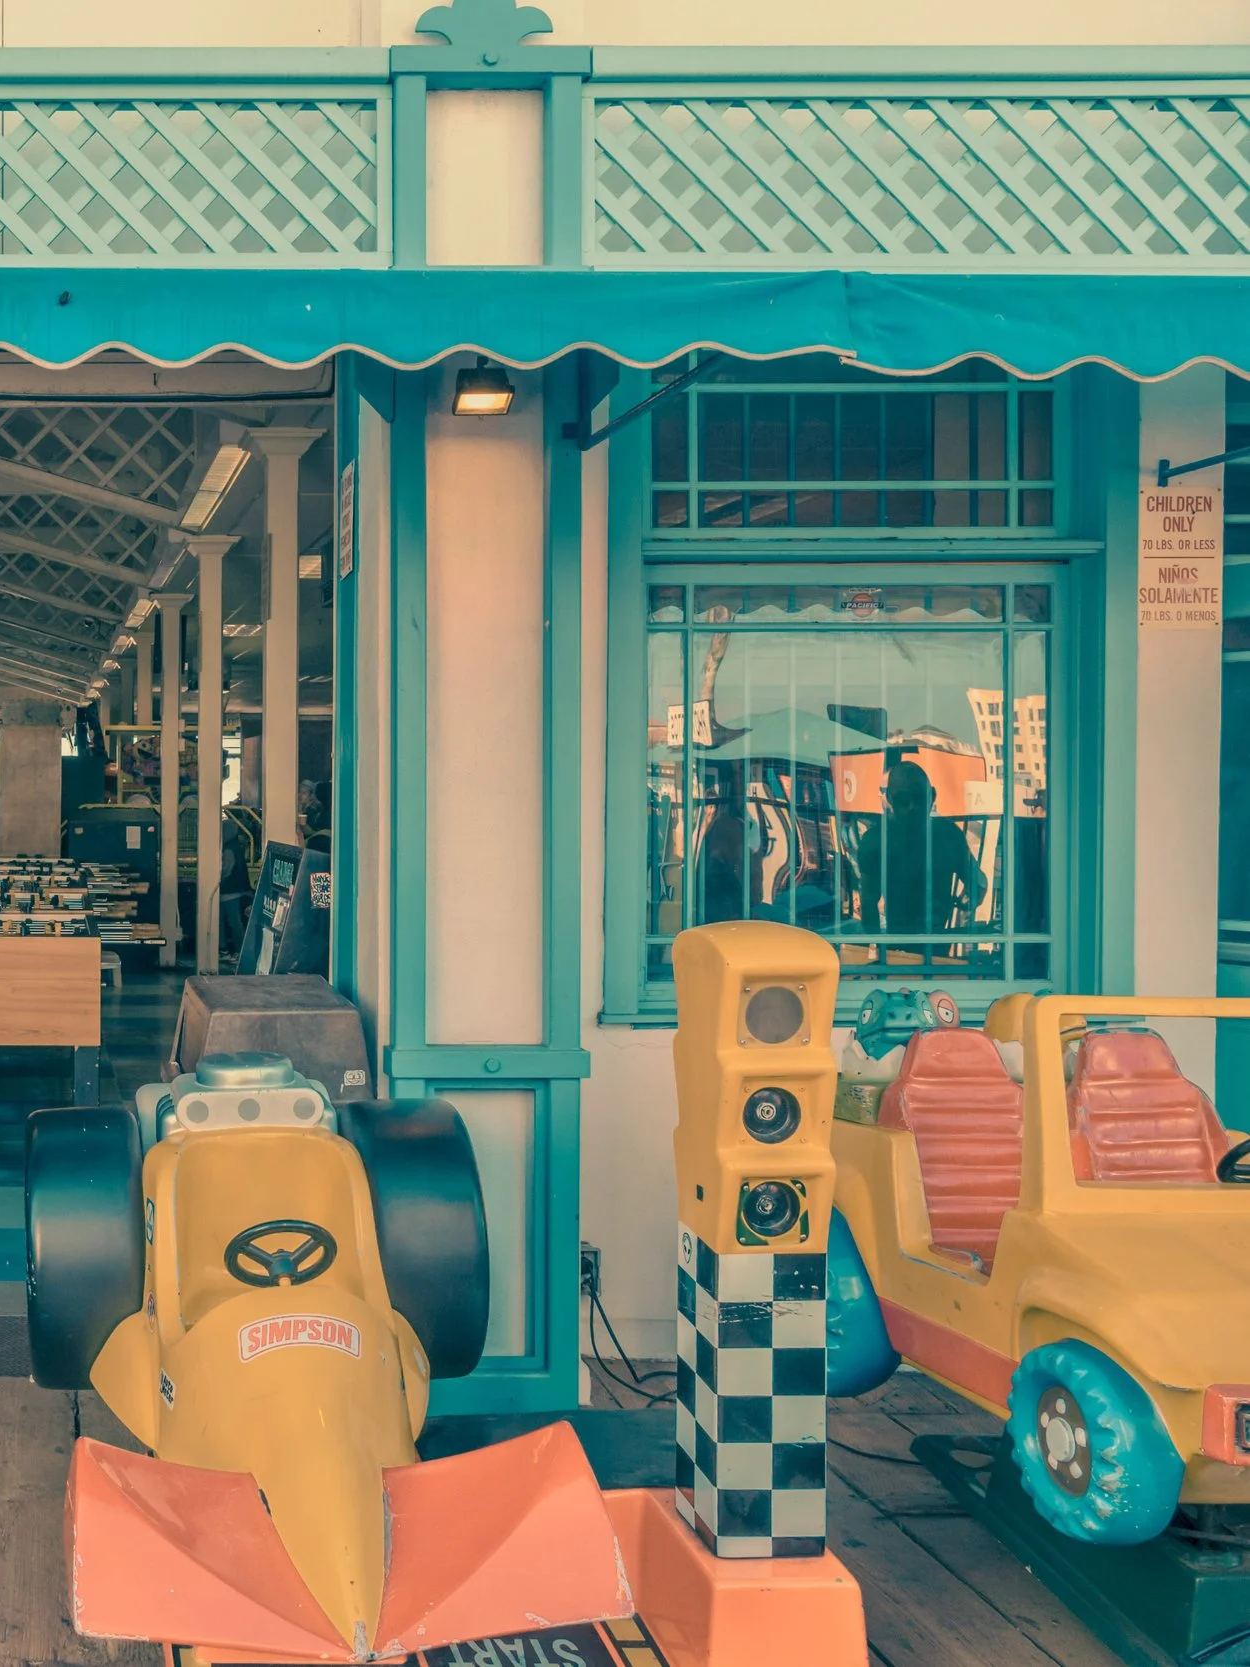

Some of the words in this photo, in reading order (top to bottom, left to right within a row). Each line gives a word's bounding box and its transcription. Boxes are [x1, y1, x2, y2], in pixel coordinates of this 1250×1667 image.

[1146, 495, 1212, 513] CHILDREN
[1163, 516, 1195, 532] ONLY
[1142, 539, 1153, 550] 70
[1156, 539, 1175, 550] LBS.
[1178, 539, 1191, 550] OR
[1194, 539, 1216, 550] LESS
[1158, 564, 1199, 584] NIÑOS
[1139, 587, 1219, 604] SOLAMENTE
[1141, 610, 1151, 621] 70
[1154, 610, 1174, 621] LBS.
[1185, 610, 1216, 621] MENOS
[247, 1319, 352, 1352] SIMPSON
[448, 1637, 588, 1667] START
